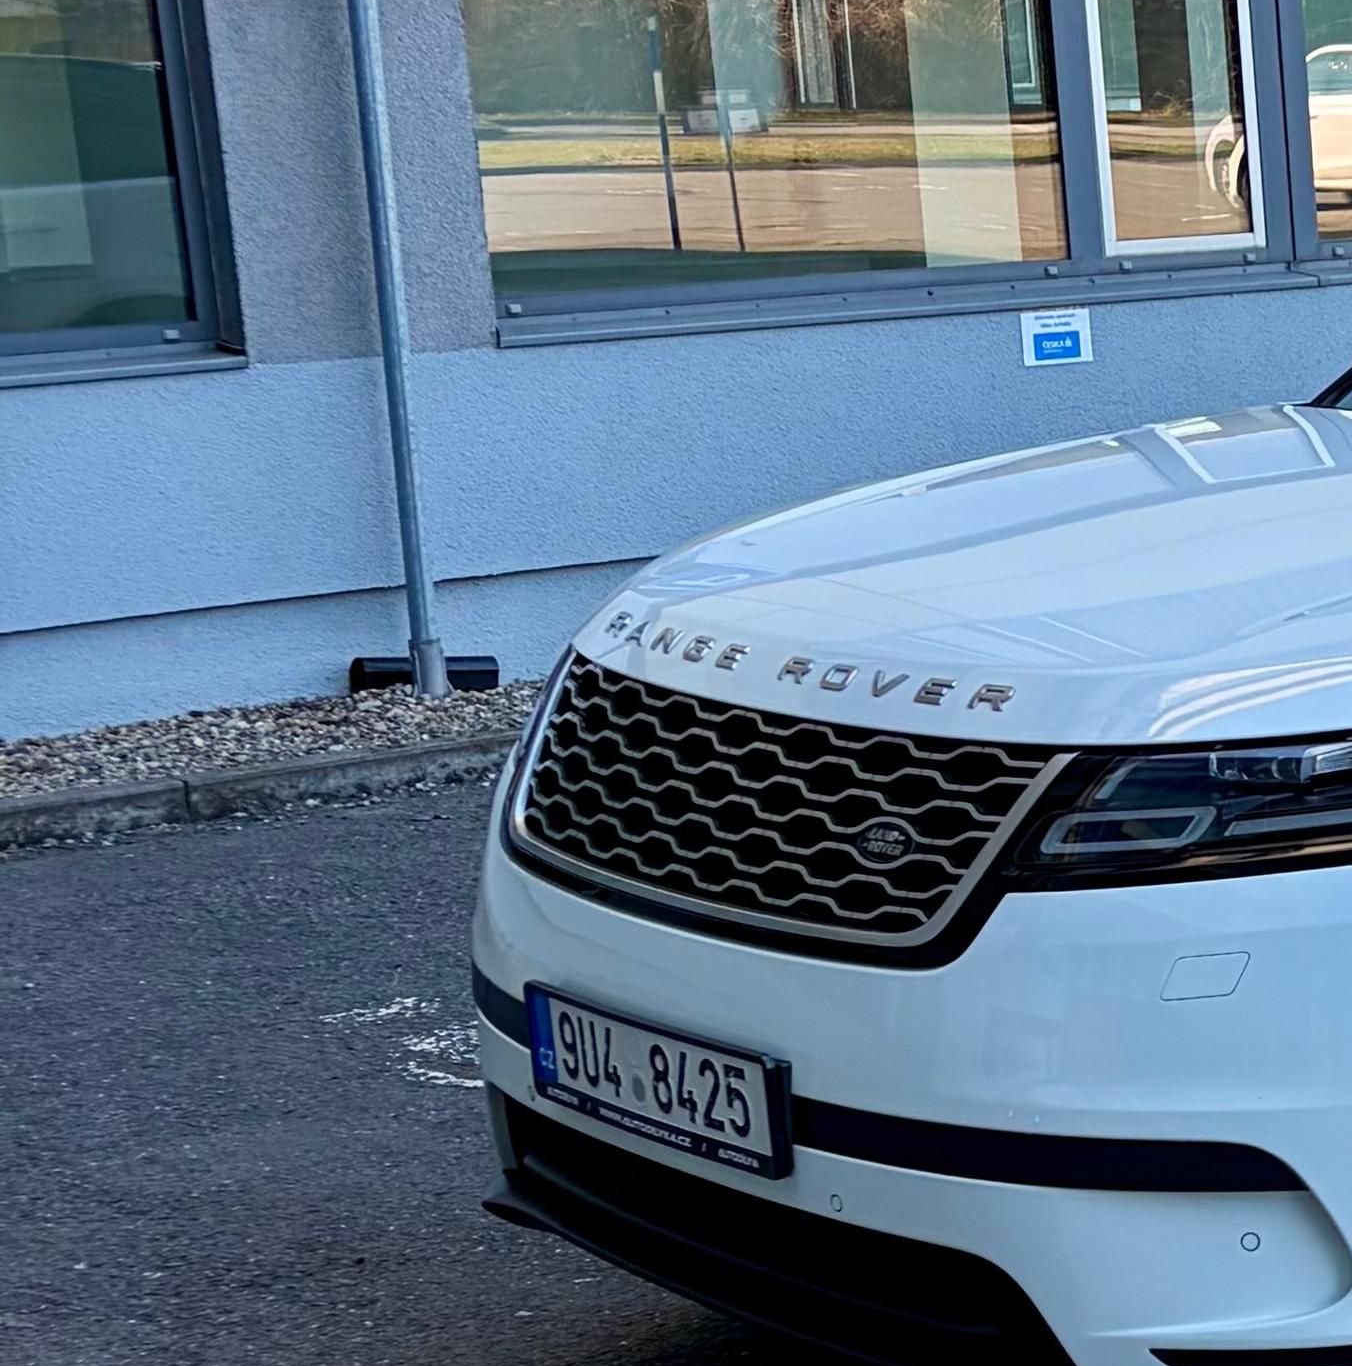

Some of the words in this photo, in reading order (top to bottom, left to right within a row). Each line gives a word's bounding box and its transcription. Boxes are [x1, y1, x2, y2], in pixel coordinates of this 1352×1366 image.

[604, 610, 751, 671] RANGE
[777, 656, 1017, 712] ROVER
[558, 1010, 623, 1098] 9U4
[649, 1043, 751, 1138] 8425
